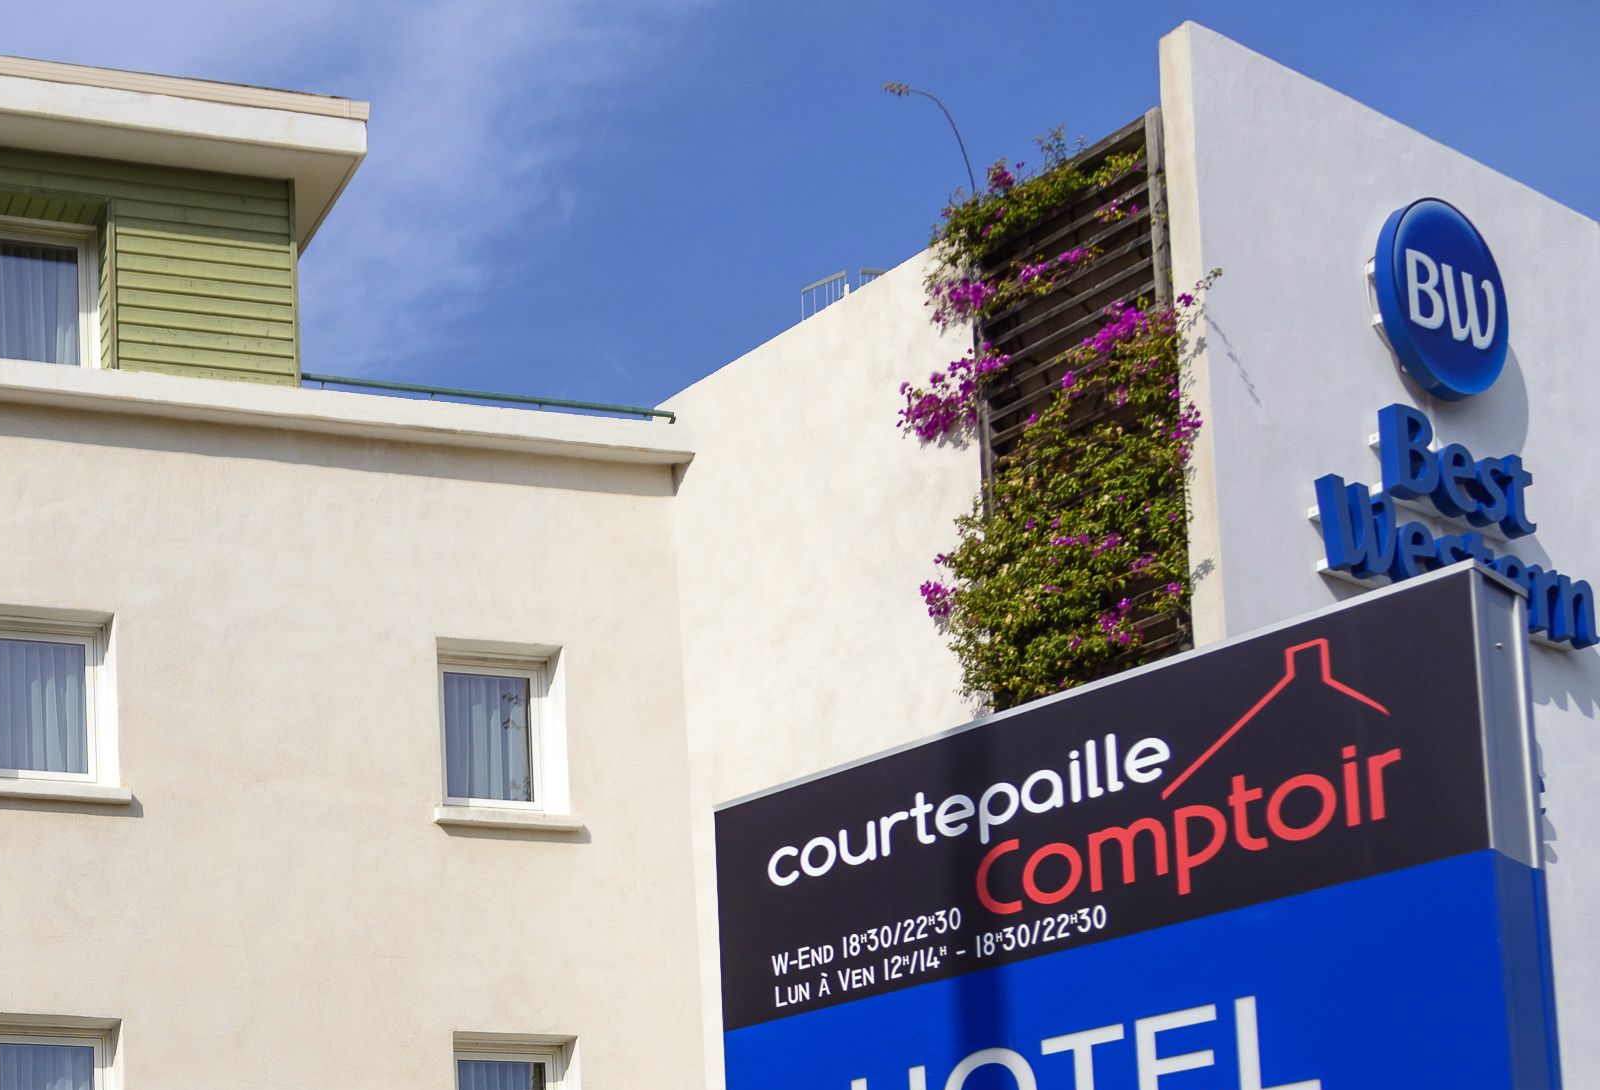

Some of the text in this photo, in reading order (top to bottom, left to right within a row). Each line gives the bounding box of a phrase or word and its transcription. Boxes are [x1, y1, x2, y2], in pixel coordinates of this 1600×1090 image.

[1404, 247, 1496, 351] BW
[1378, 403, 1537, 540] Best
[766, 732, 1172, 887] courtepaille
[975, 744, 1402, 915] Comptoir
[771, 944, 834, 976] W-END
[774, 982, 811, 1008] LUN
[818, 972, 831, 998] À
[837, 966, 875, 992] VEN
